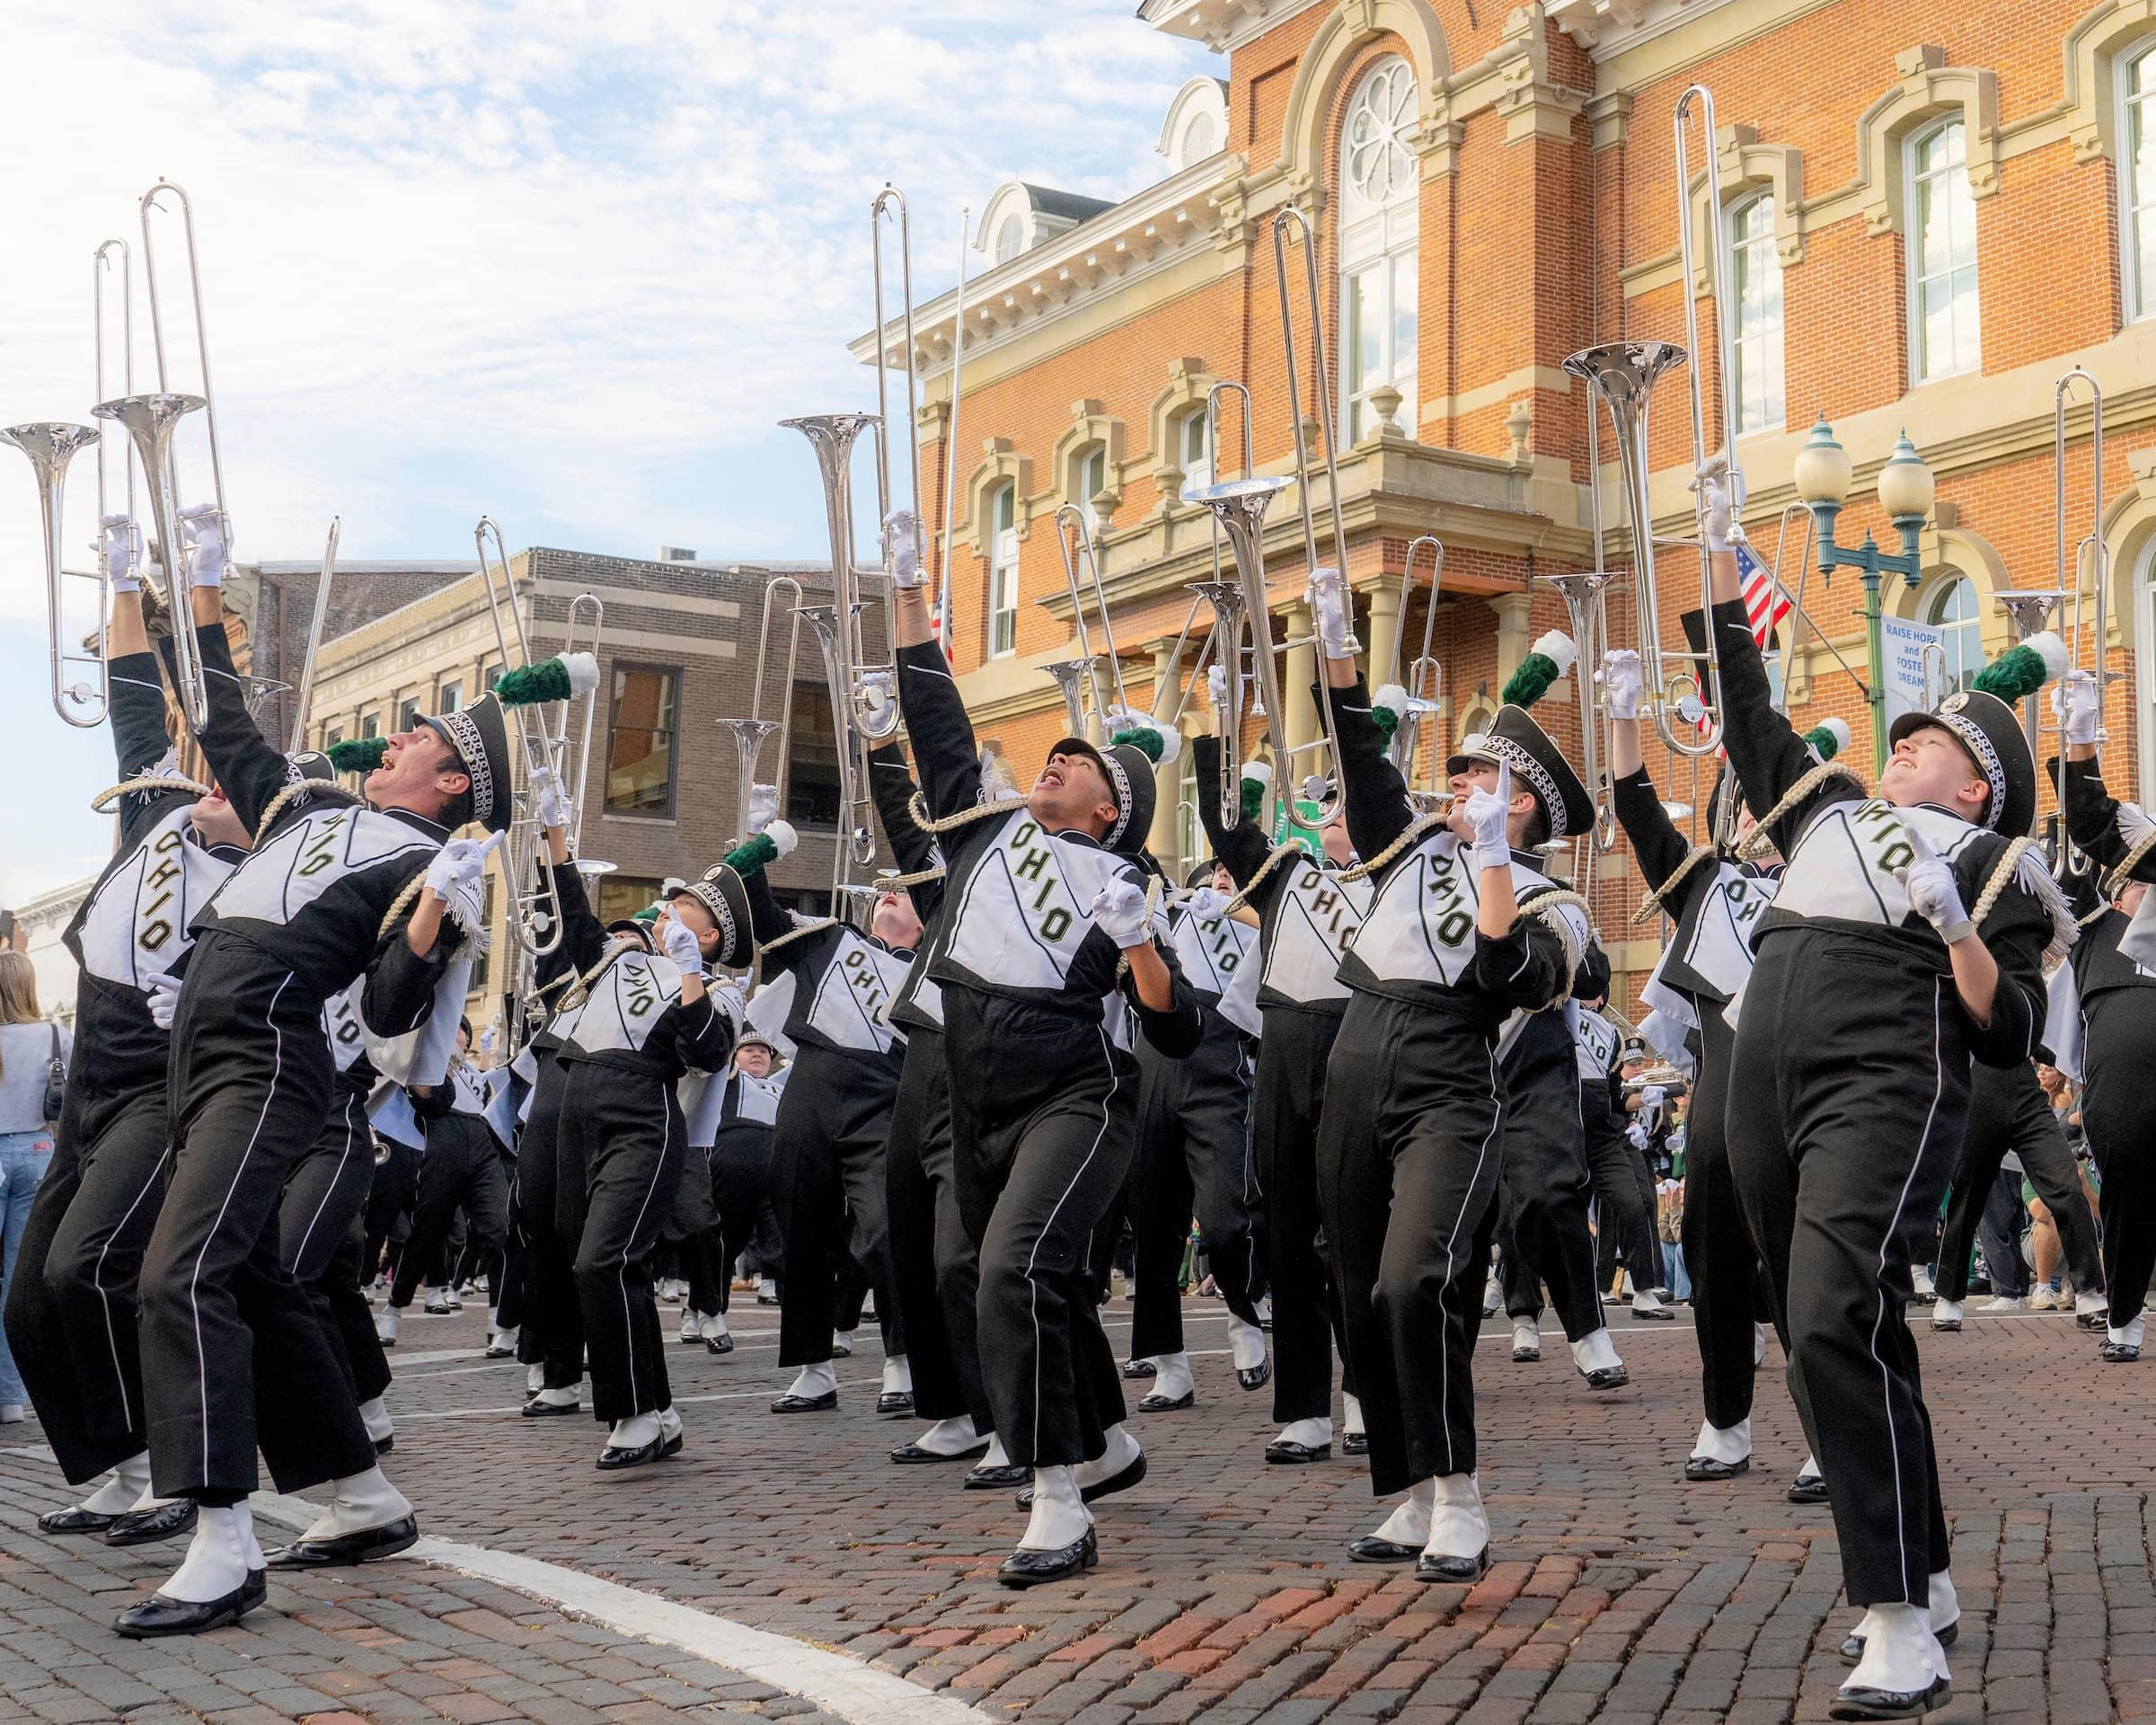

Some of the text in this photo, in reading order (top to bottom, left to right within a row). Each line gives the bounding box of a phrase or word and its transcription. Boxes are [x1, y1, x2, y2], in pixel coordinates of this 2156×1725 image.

[1886, 624, 1938, 643] RAISE HOPE
[1904, 646, 1920, 657] and
[1897, 657, 1923, 672] FOSTE
[1897, 671, 1924, 687] DREAM
[1852, 799, 1916, 876] OHIO
[137, 829, 183, 952] OHIO
[465, 880, 482, 902] OHI
[1010, 820, 1074, 943] OHIO
[1427, 854, 1474, 948] OHIO
[1725, 878, 1763, 922] OH
[1299, 870, 1358, 952] OHIO
[1199, 917, 1240, 973] HIO
[1579, 1020, 1607, 1060] HIO
